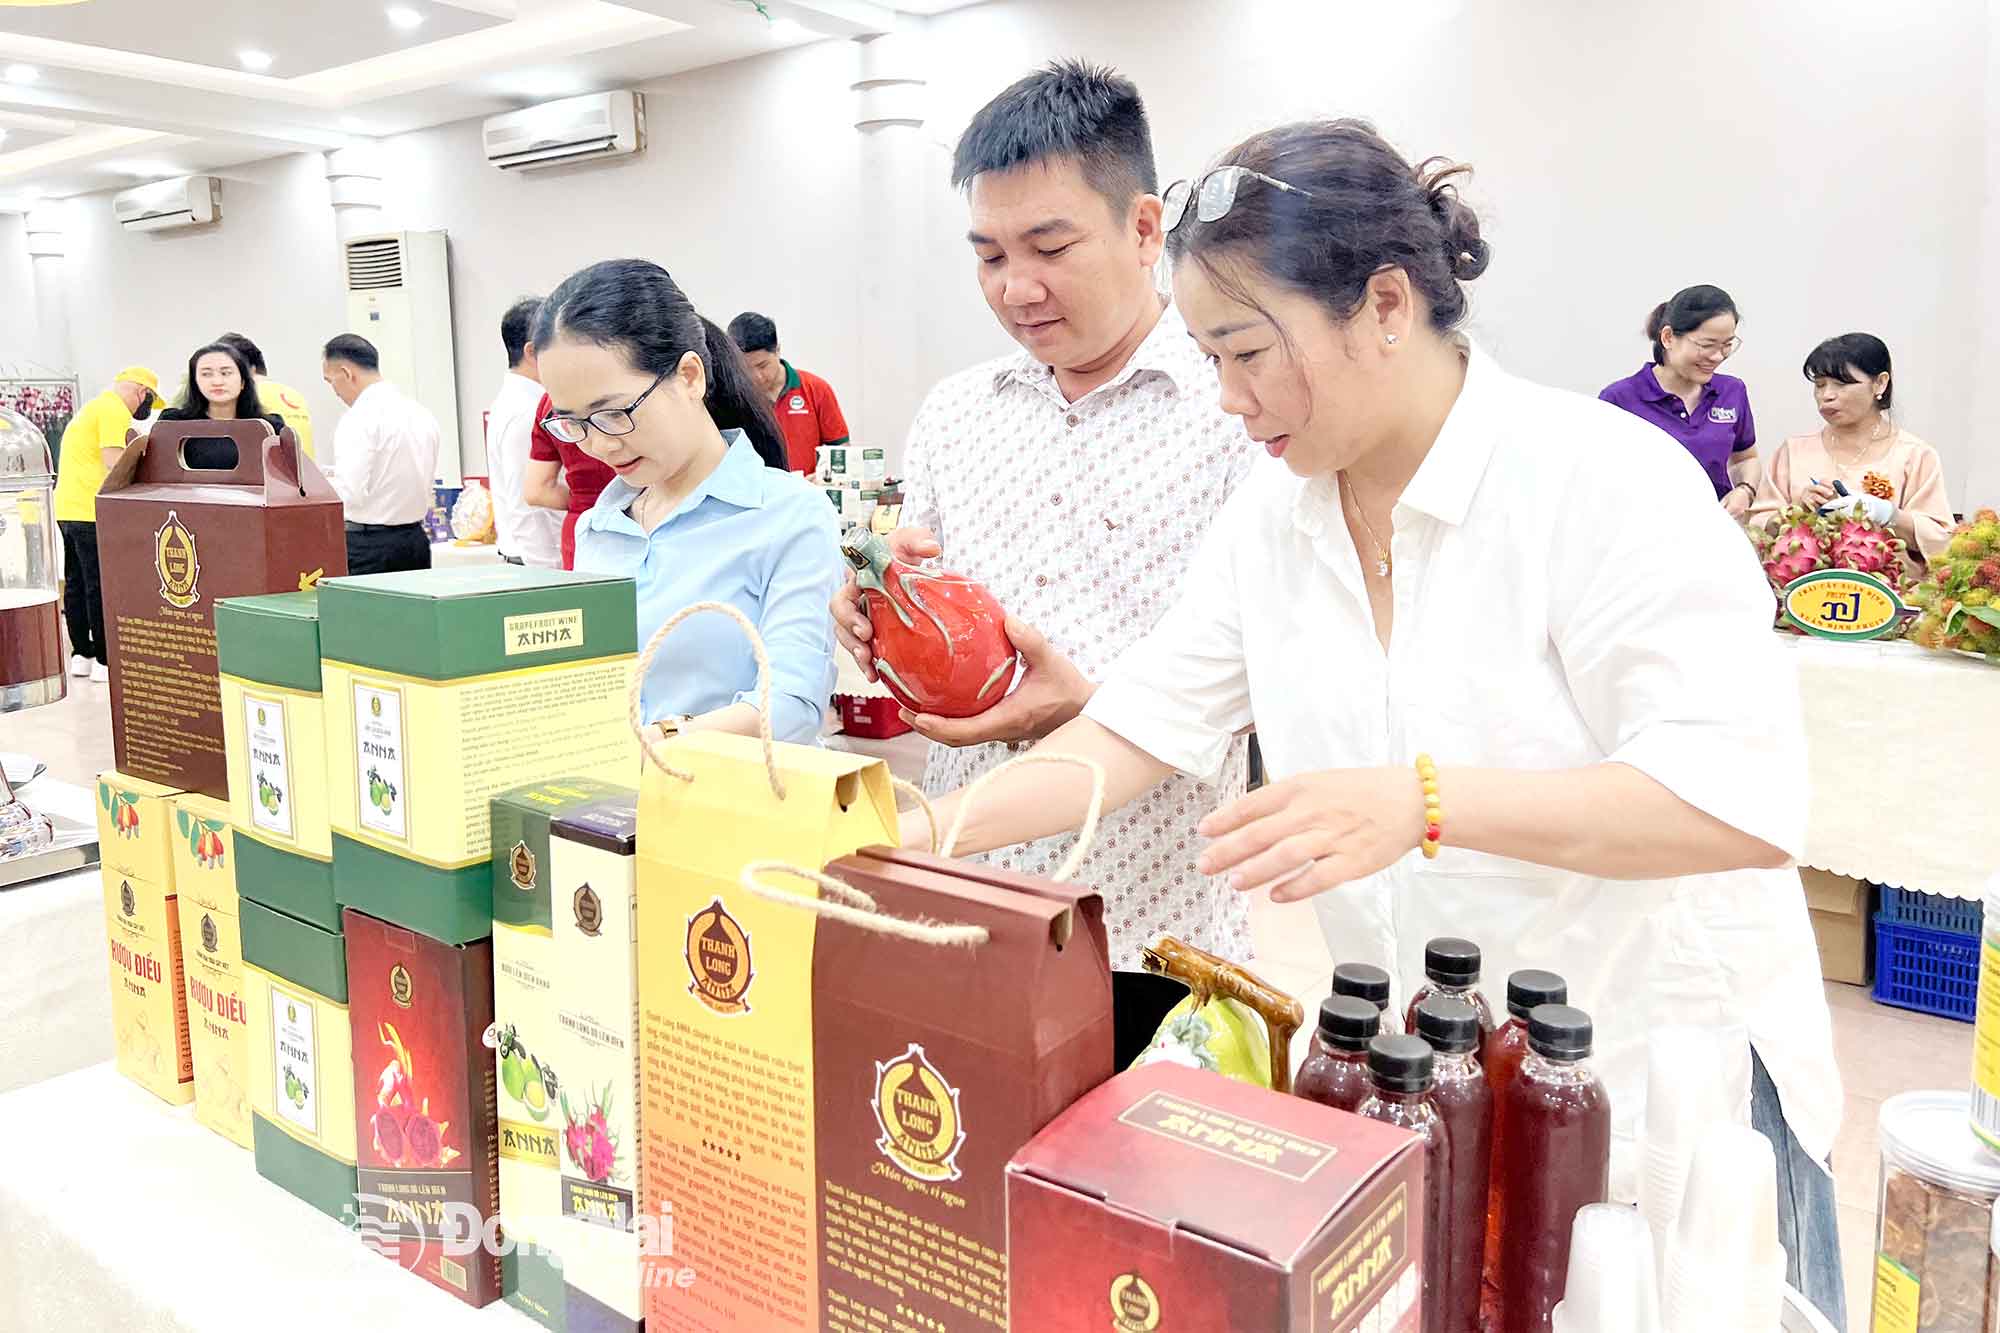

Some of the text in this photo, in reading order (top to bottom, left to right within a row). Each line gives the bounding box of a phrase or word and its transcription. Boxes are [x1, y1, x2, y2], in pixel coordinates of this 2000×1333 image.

[558, 615, 577, 625] WINE
[517, 627, 573, 647] ANNA
[253, 748, 281, 766] ANNA
[363, 741, 396, 760] ANNA
[702, 938, 737, 958] THANH
[706, 956, 732, 977] LONG
[896, 1088, 938, 1117] THANH
[902, 1110, 933, 1135] LONG
[503, 1129, 556, 1156] ANNA
[385, 1198, 450, 1225] ANNA
[1331, 1235, 1393, 1320] ANNA
